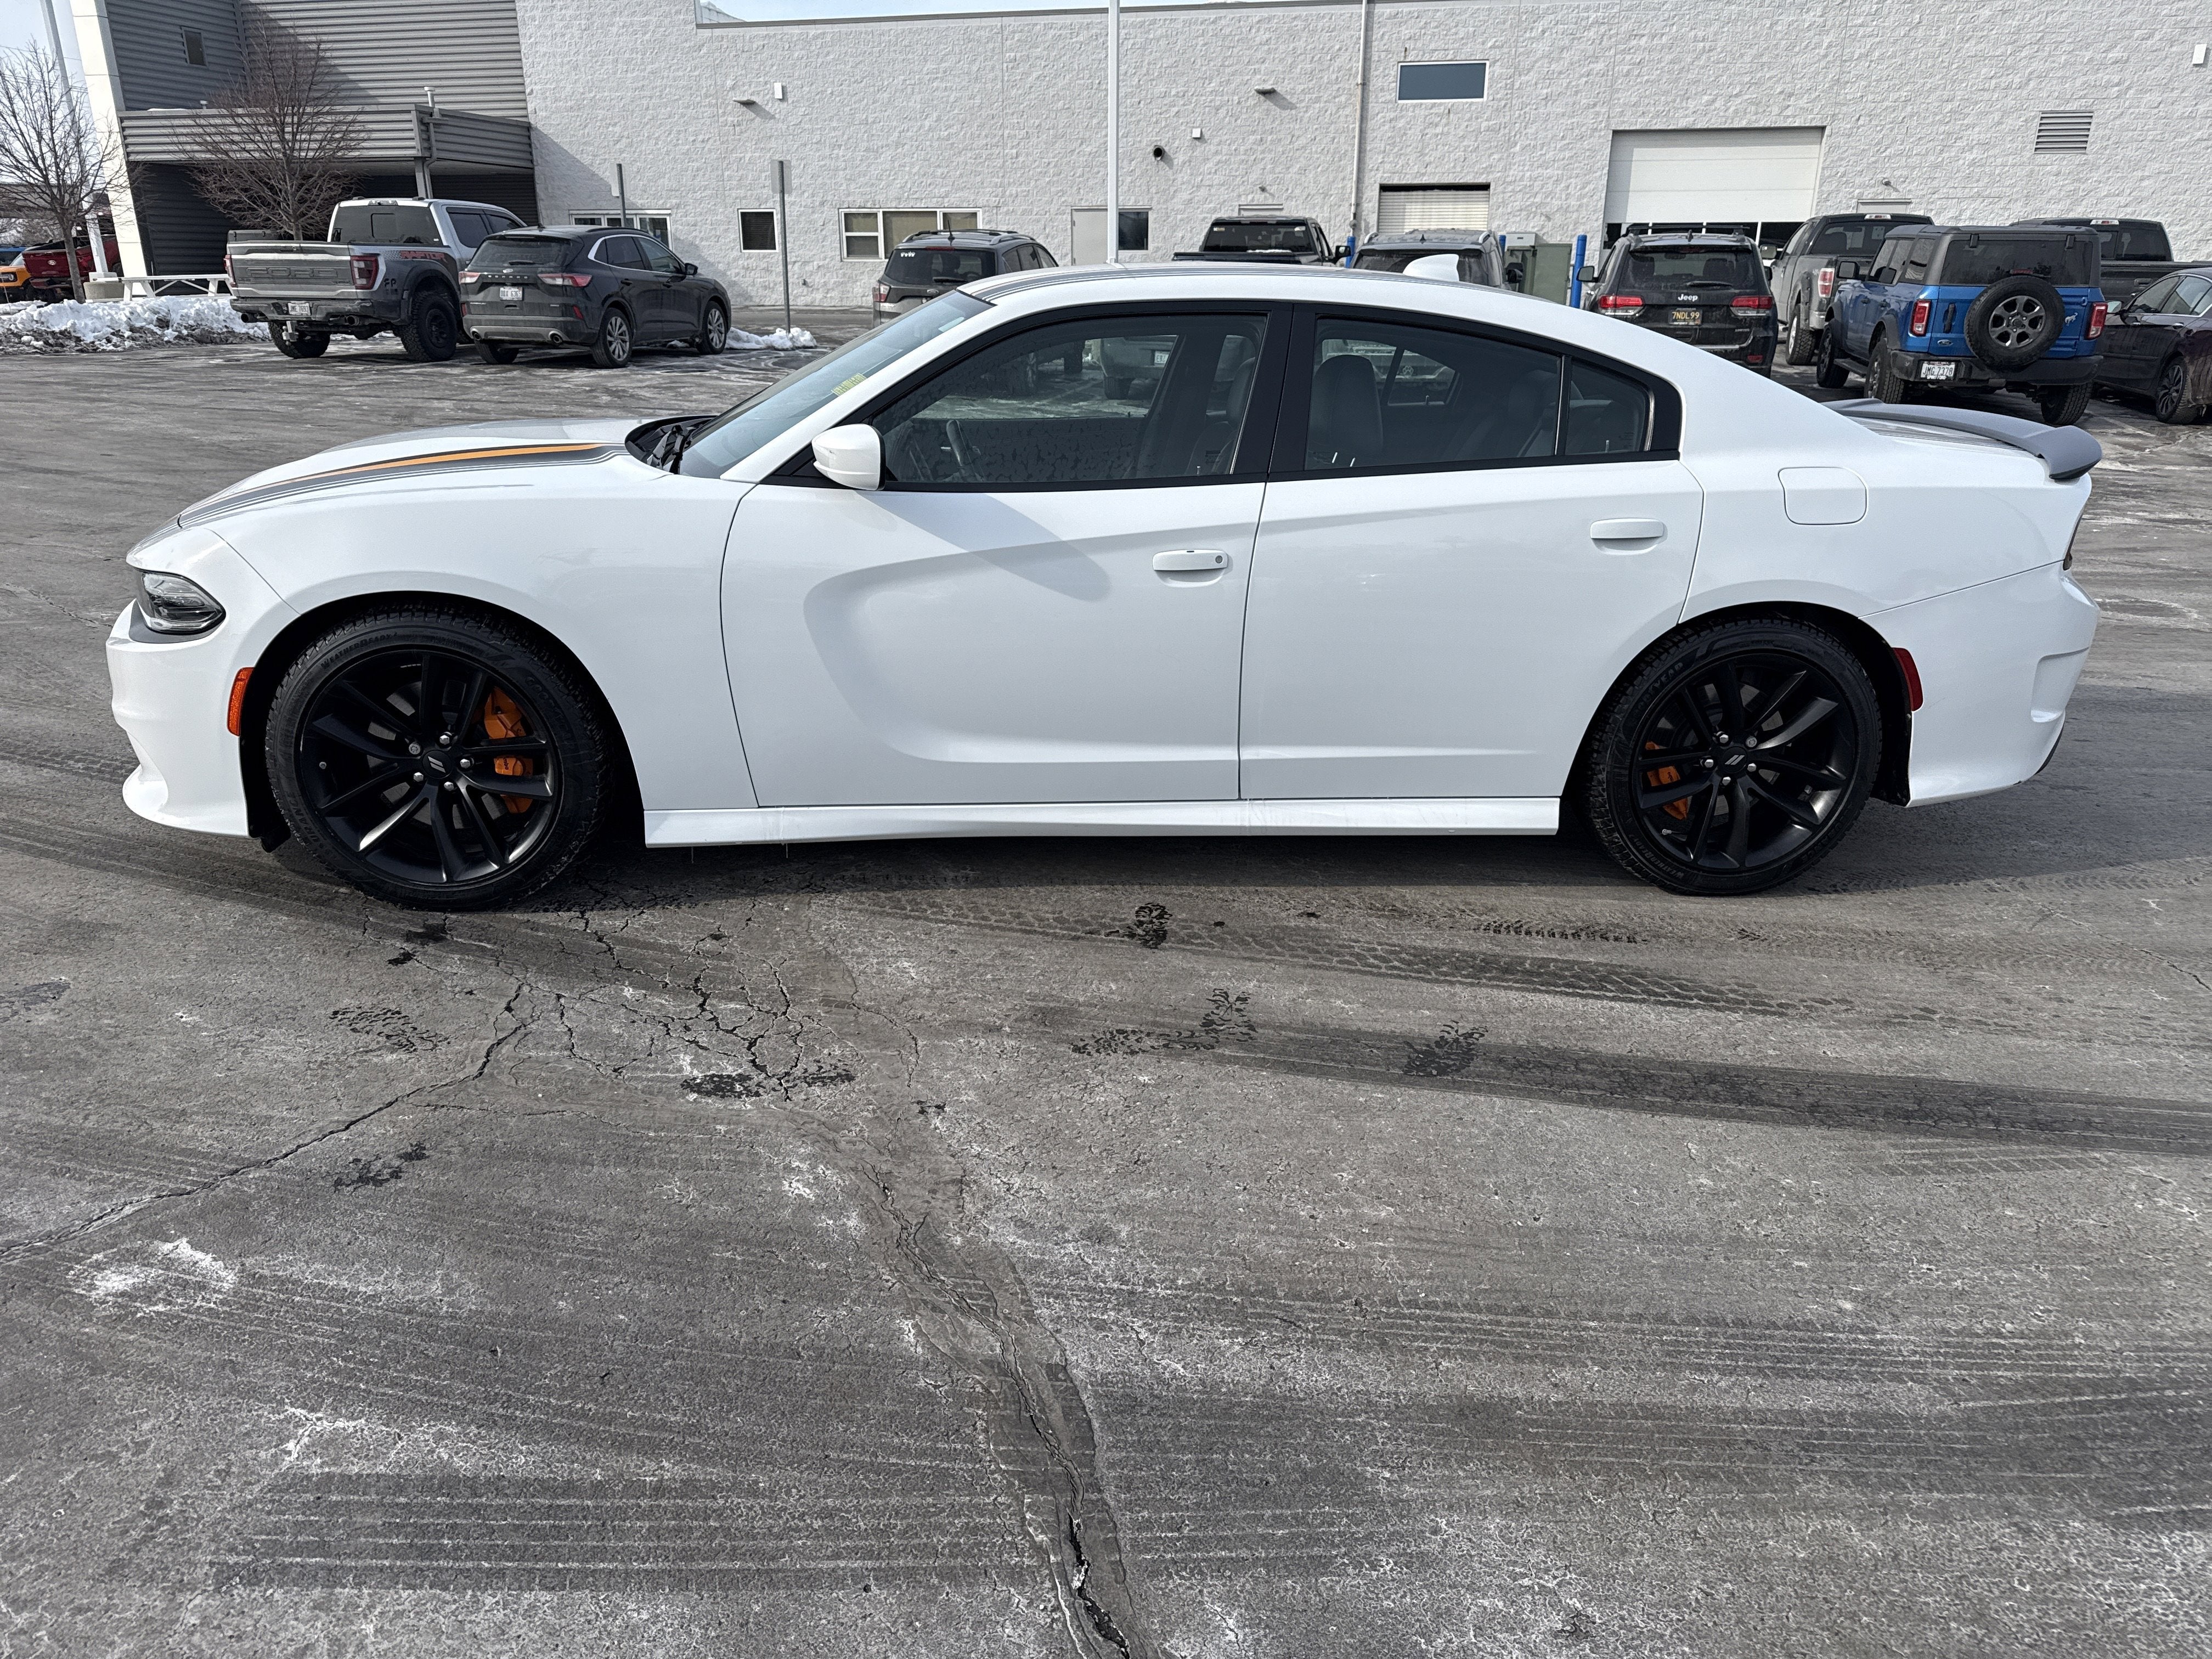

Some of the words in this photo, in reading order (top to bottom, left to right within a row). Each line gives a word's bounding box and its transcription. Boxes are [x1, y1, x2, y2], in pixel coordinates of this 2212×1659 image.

[246, 267, 338, 278] FORD
[1678, 294, 1699, 302] Jeep
[1672, 311, 1700, 319] 7NDL99
[1937, 366, 1953, 377] 7378
